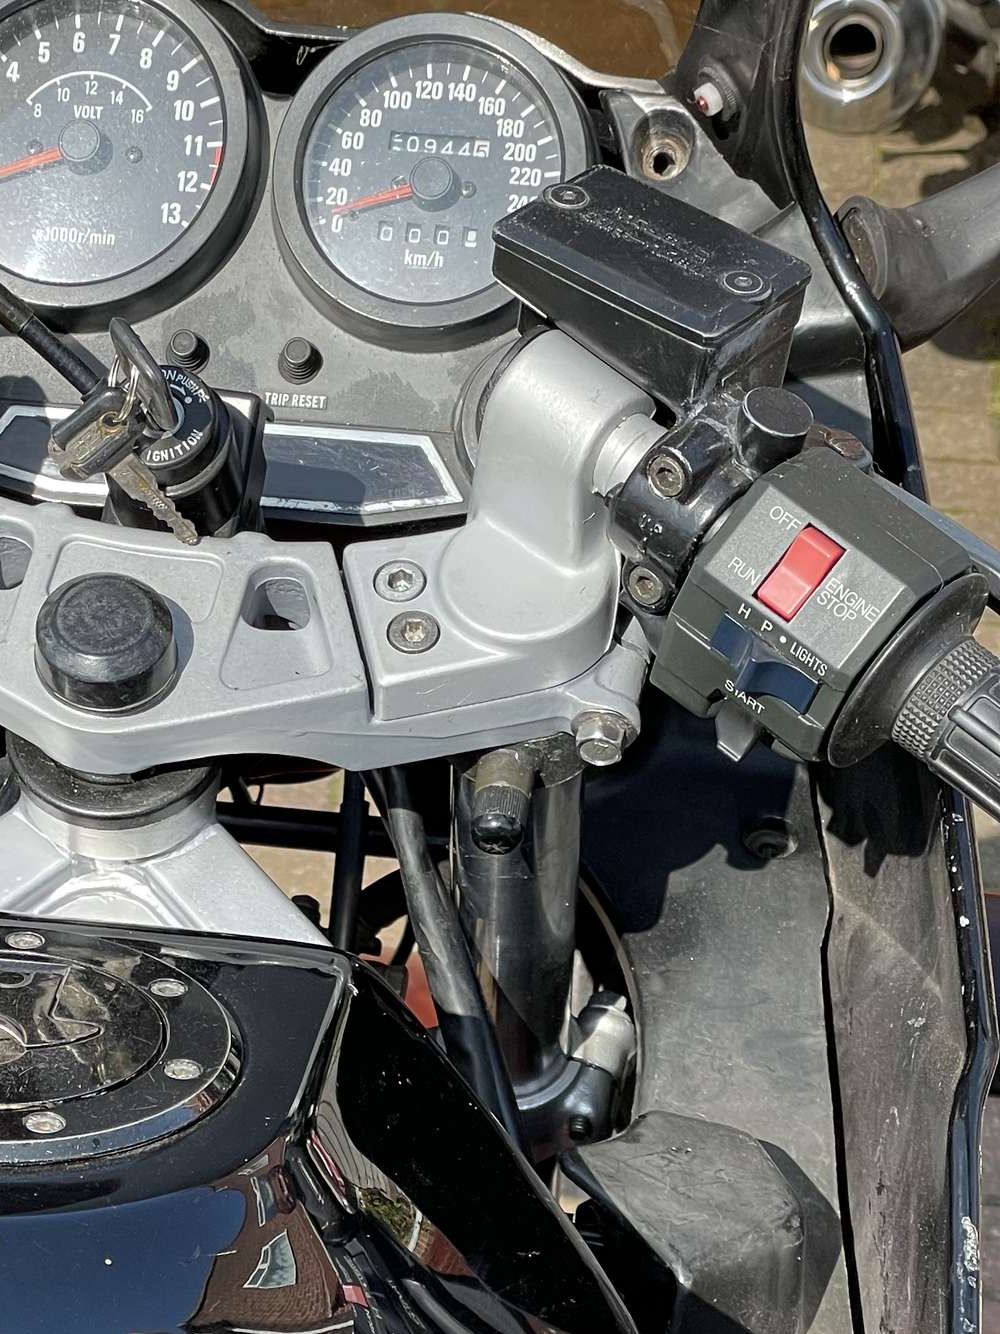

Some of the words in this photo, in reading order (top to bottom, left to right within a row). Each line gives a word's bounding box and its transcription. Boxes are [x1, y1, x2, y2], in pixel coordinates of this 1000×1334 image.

[38, 41, 50, 64] 5
[72, 32, 86, 53] 6
[109, 34, 121, 55] 7
[140, 47, 152, 69] 8
[6, 61, 20, 82] 4
[166, 70, 180, 91] 9
[56, 88, 70, 102] 10
[85, 80, 98, 96] 12
[110, 90, 124, 105] 14
[415, 81, 443, 100] 120
[448, 83, 477, 102] 140
[383, 90, 412, 110] 100
[478, 97, 506, 116] 160
[33, 104, 42, 118] 8
[73, 105, 104, 120] VOLT
[131, 108, 144, 123] 16
[173, 100, 194, 121] 10
[360, 109, 382, 128] 80
[496, 119, 524, 139] 180
[184, 135, 202, 156] 11
[341, 132, 364, 150] 60
[503, 142, 537, 162] 200
[329, 158, 352, 177] 40
[509, 167, 542, 187] 220
[177, 171, 198, 192] 12
[326, 188, 348, 206] 20
[506, 194, 539, 214] 24
[160, 203, 181, 225] 13
[332, 214, 343, 233] 0
[404, 249, 444, 268] km/h
[175, 375, 199, 395] PUSH
[264, 392, 290, 407] TRIP
[292, 393, 328, 409] RESET
[146, 429, 203, 461] IGNITION
[769, 505, 802, 532] OFF
[727, 557, 761, 586] RUN
[816, 592, 857, 623] STOP
[823, 577, 881, 622] ENGINE
[737, 603, 752, 620] H
[761, 620, 773, 633] P
[790, 642, 828, 677] LIGHTS
